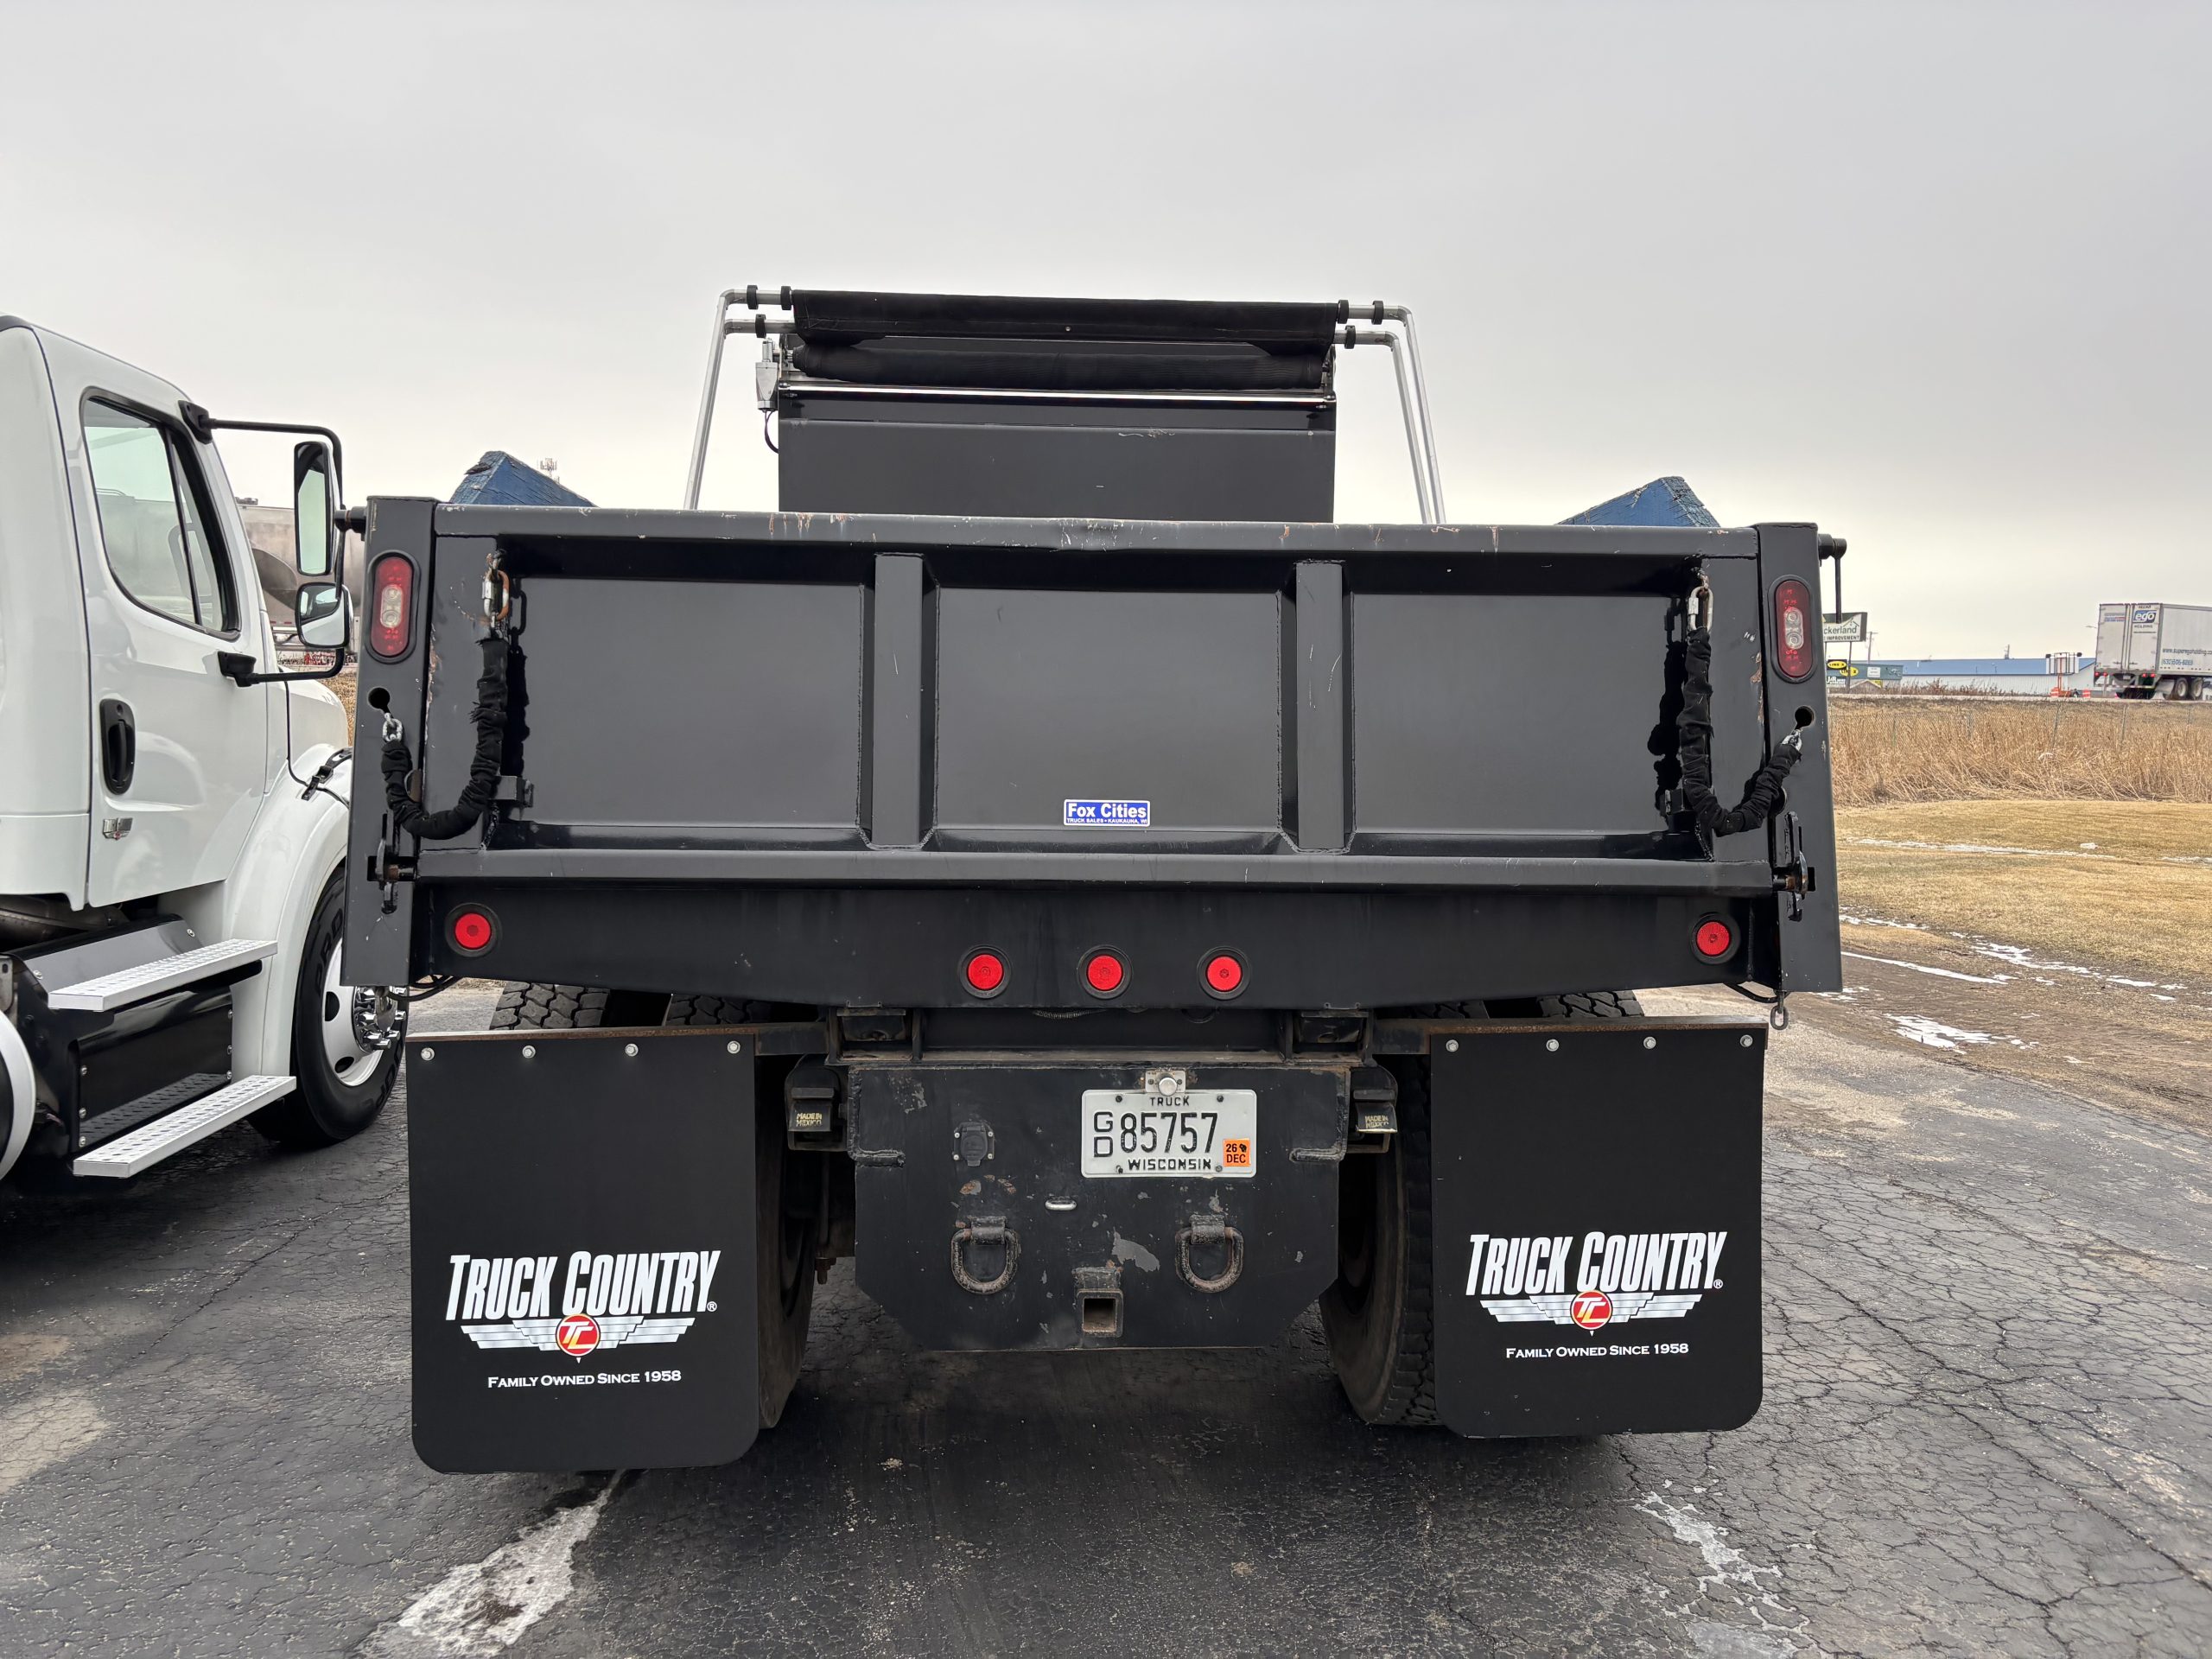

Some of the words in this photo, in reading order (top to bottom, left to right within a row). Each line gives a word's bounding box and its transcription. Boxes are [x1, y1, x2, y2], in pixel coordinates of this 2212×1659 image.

[1824, 626, 1857, 634] ckerland
[1068, 803, 1096, 817] Fox
[1100, 804, 1147, 818] Cities
[1150, 1096, 1190, 1106] TRUCK
[1121, 1112, 1218, 1154] 85757
[1225, 1144, 1237, 1153] 26
[1128, 1158, 1211, 1171] WISCONSIN
[1226, 1154, 1246, 1163] DEC
[1465, 1235, 1573, 1296] TRUCK
[445, 1255, 557, 1321] TRUCK
[1506, 1348, 1554, 1359] FAMILY
[1556, 1346, 1607, 1357] OWNED
[1609, 1345, 1649, 1356] SINCE
[1654, 1344, 1689, 1354] 1958
[488, 1376, 538, 1389] FAMILY
[541, 1374, 594, 1387] OWNED
[597, 1372, 639, 1384] SINCE
[644, 1370, 681, 1382] 1958
